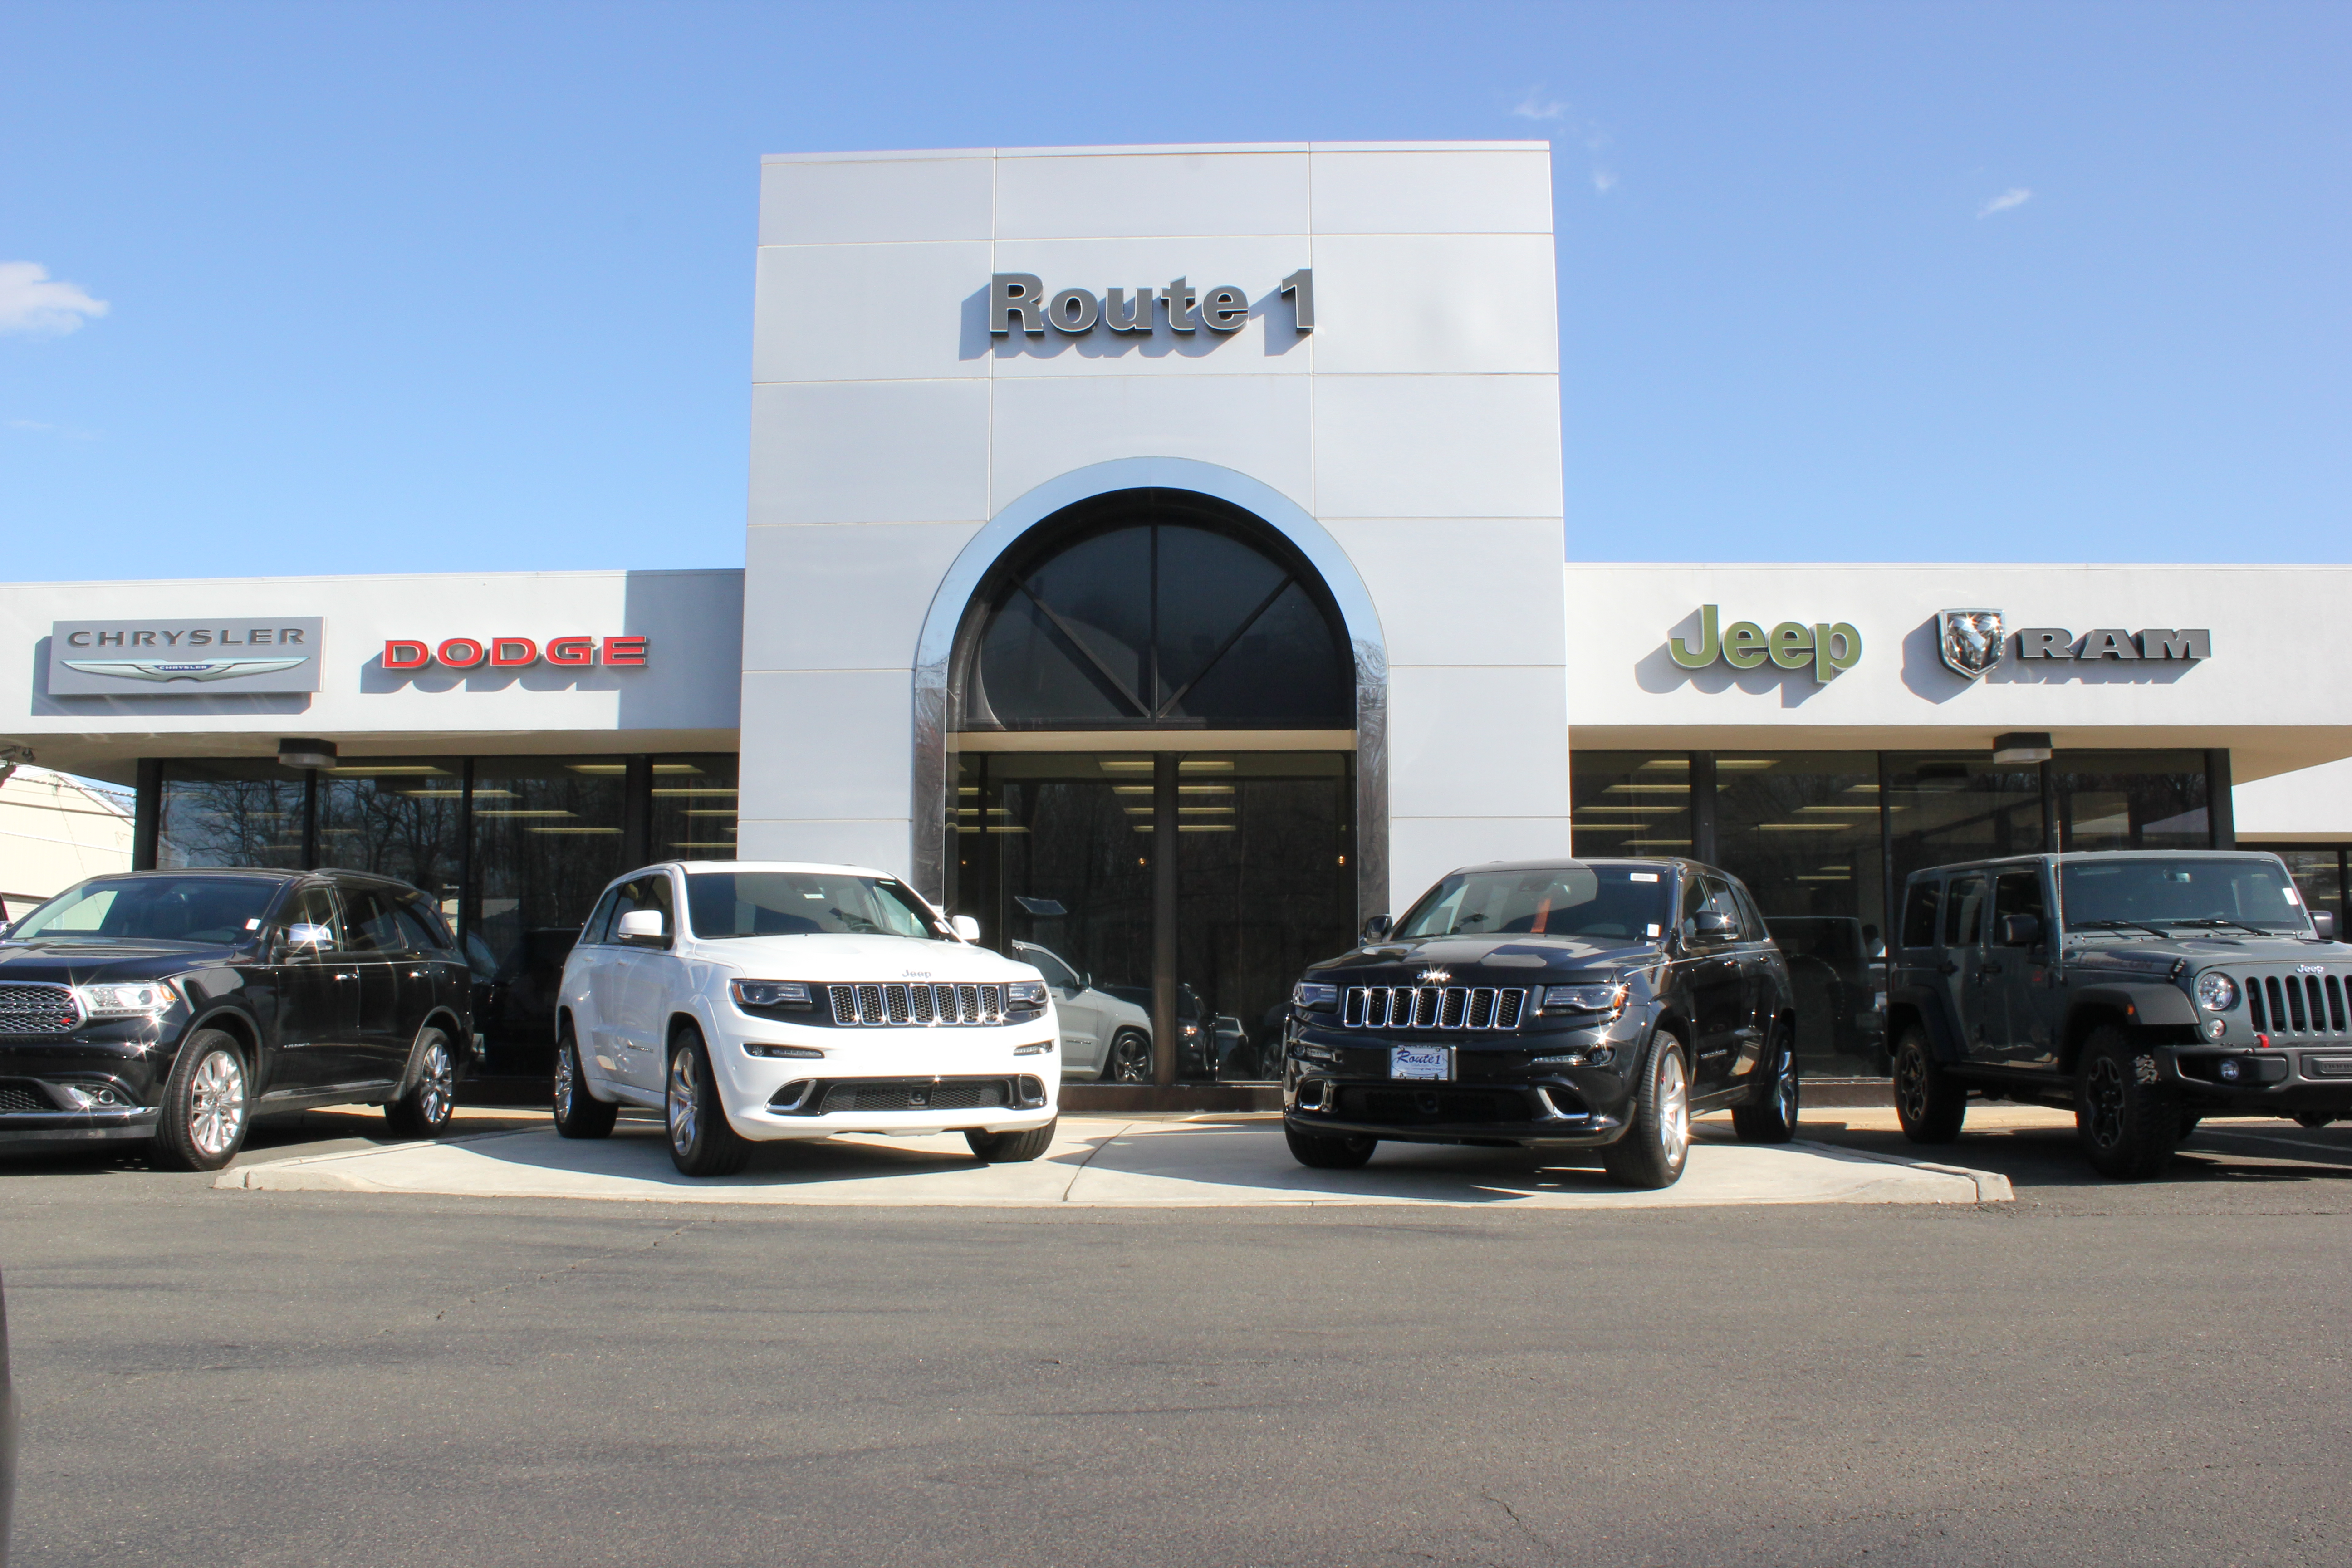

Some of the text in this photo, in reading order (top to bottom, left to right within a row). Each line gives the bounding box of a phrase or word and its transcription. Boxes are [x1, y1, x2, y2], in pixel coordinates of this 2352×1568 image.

[990, 268, 1315, 335] Route 1
[68, 628, 305, 647] CHRYSLER
[382, 635, 648, 670] DODGE
[1669, 604, 1862, 683] Jeep
[2020, 628, 2211, 660] RAM
[901, 969, 931, 979] Jeep
[2296, 964, 2324, 975] Jeep
